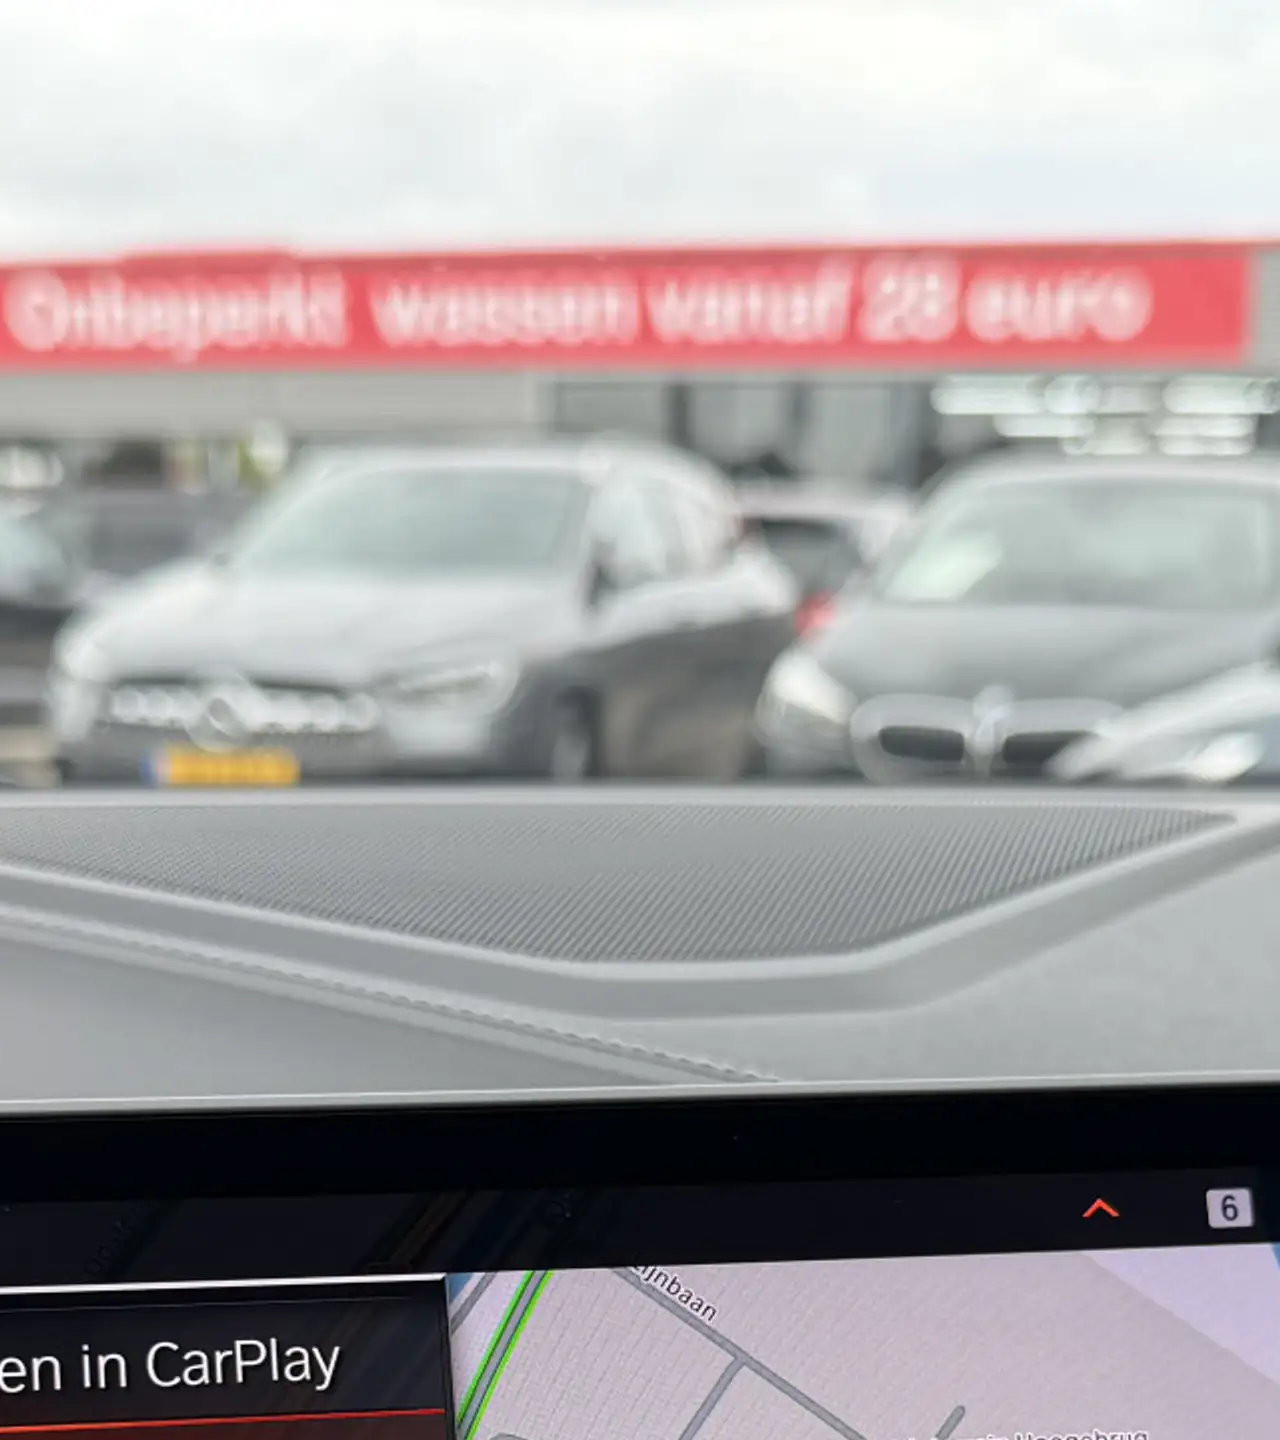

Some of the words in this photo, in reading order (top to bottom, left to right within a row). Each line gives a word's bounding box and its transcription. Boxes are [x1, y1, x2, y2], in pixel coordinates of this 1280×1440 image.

[372, 283, 639, 347] wassen
[648, 262, 849, 345] vanaf
[966, 270, 1153, 343] euro
[1221, 1195, 1239, 1222] 6
[82, 1344, 127, 1389] in
[146, 1337, 341, 1391] CarPlay
